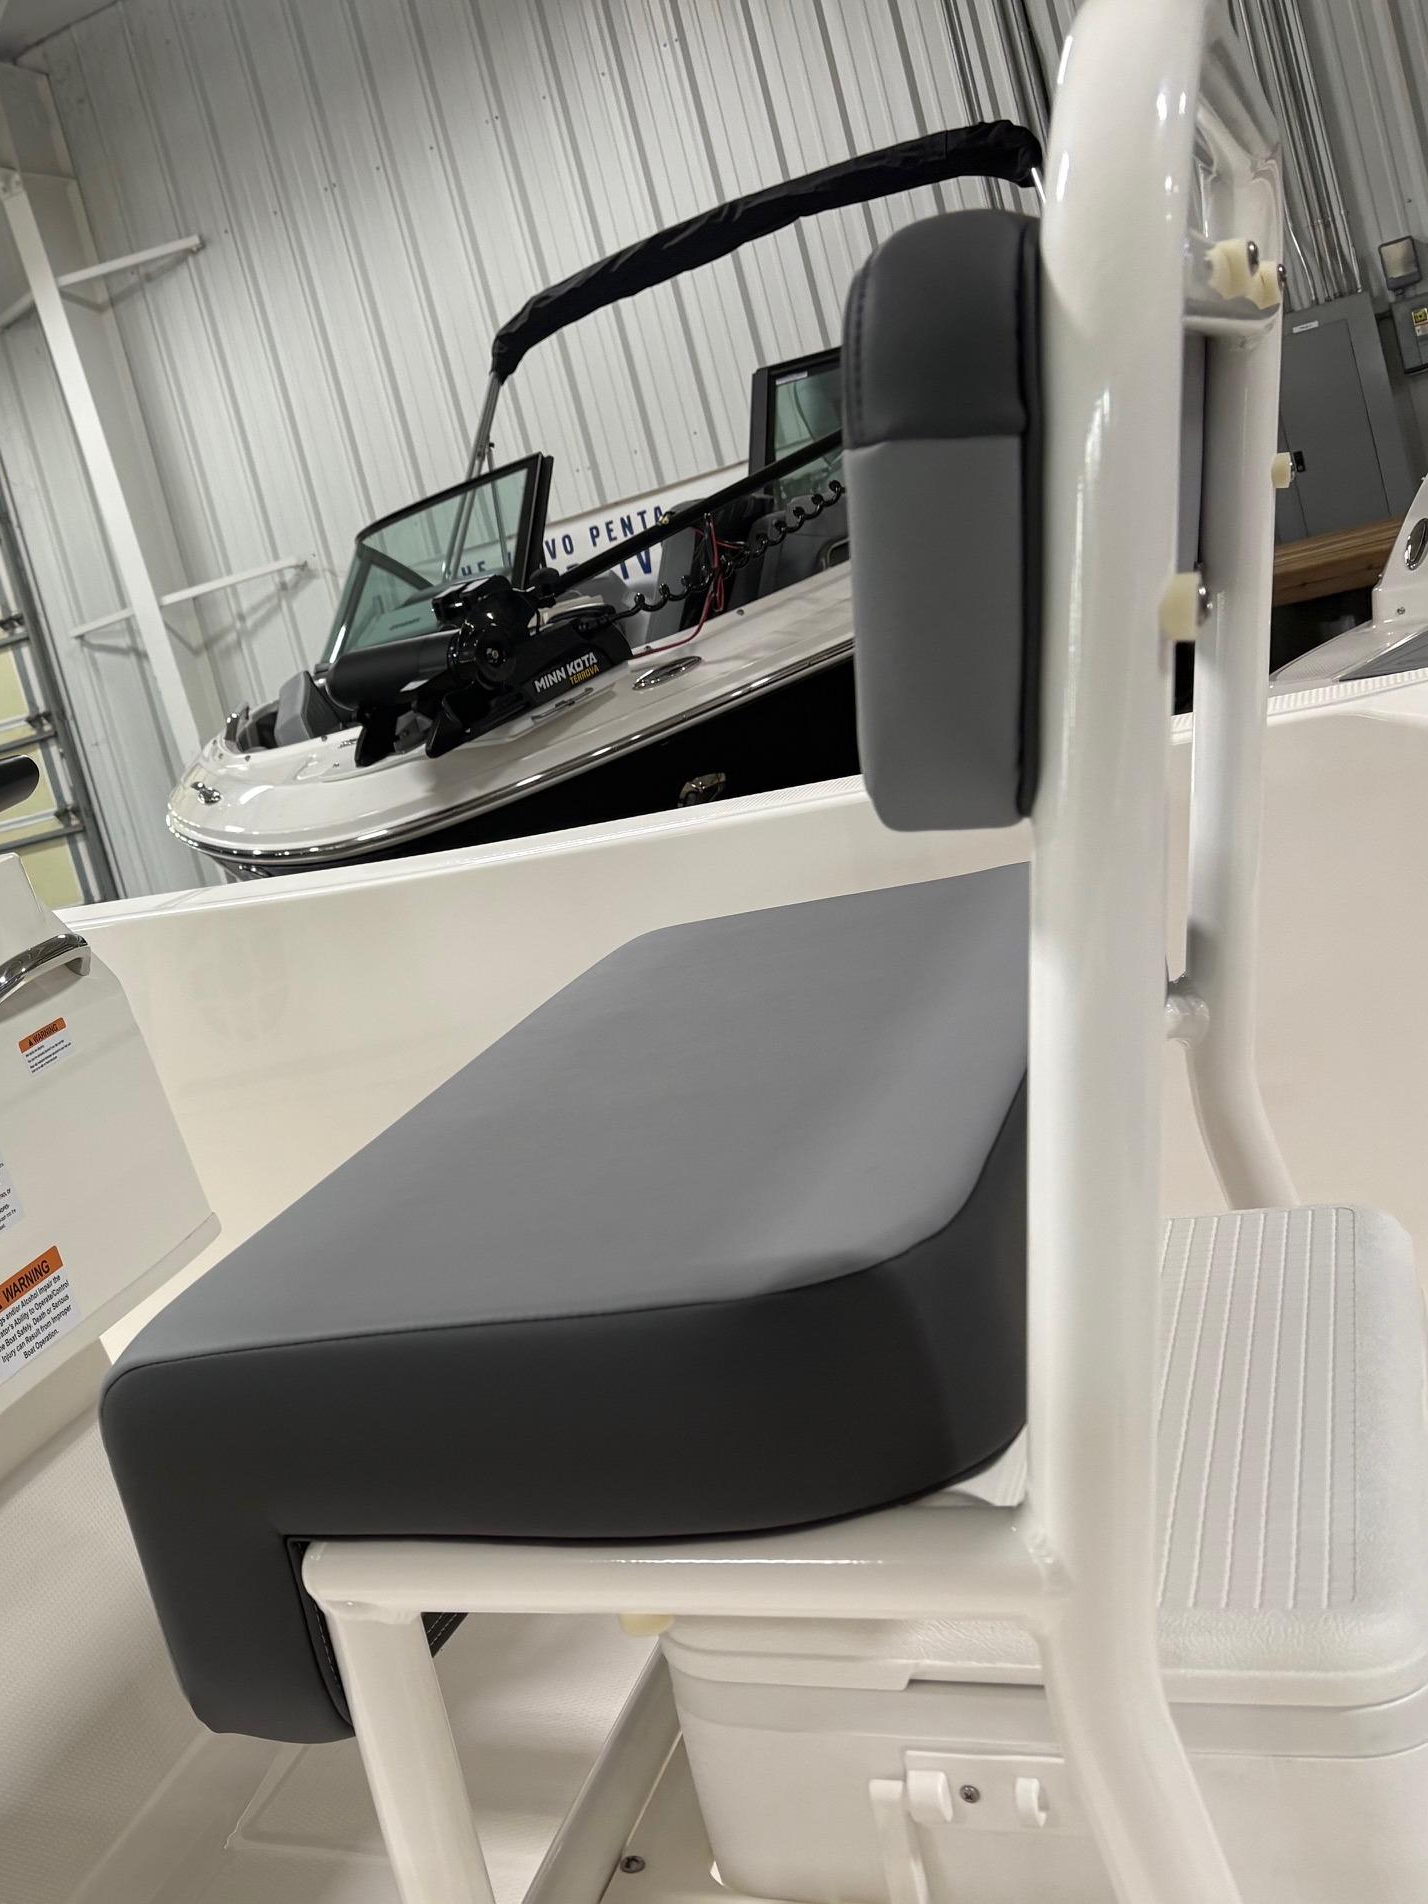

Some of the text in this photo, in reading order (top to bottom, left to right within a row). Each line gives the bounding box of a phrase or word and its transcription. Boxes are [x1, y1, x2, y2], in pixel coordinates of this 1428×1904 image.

[534, 651, 598, 693] MINN KOTA
[570, 664, 600, 685] TERROVA
[2, 1258, 51, 1303] WARNING
[13, 1310, 29, 1327] Ability
[28, 1306, 35, 1315] to
